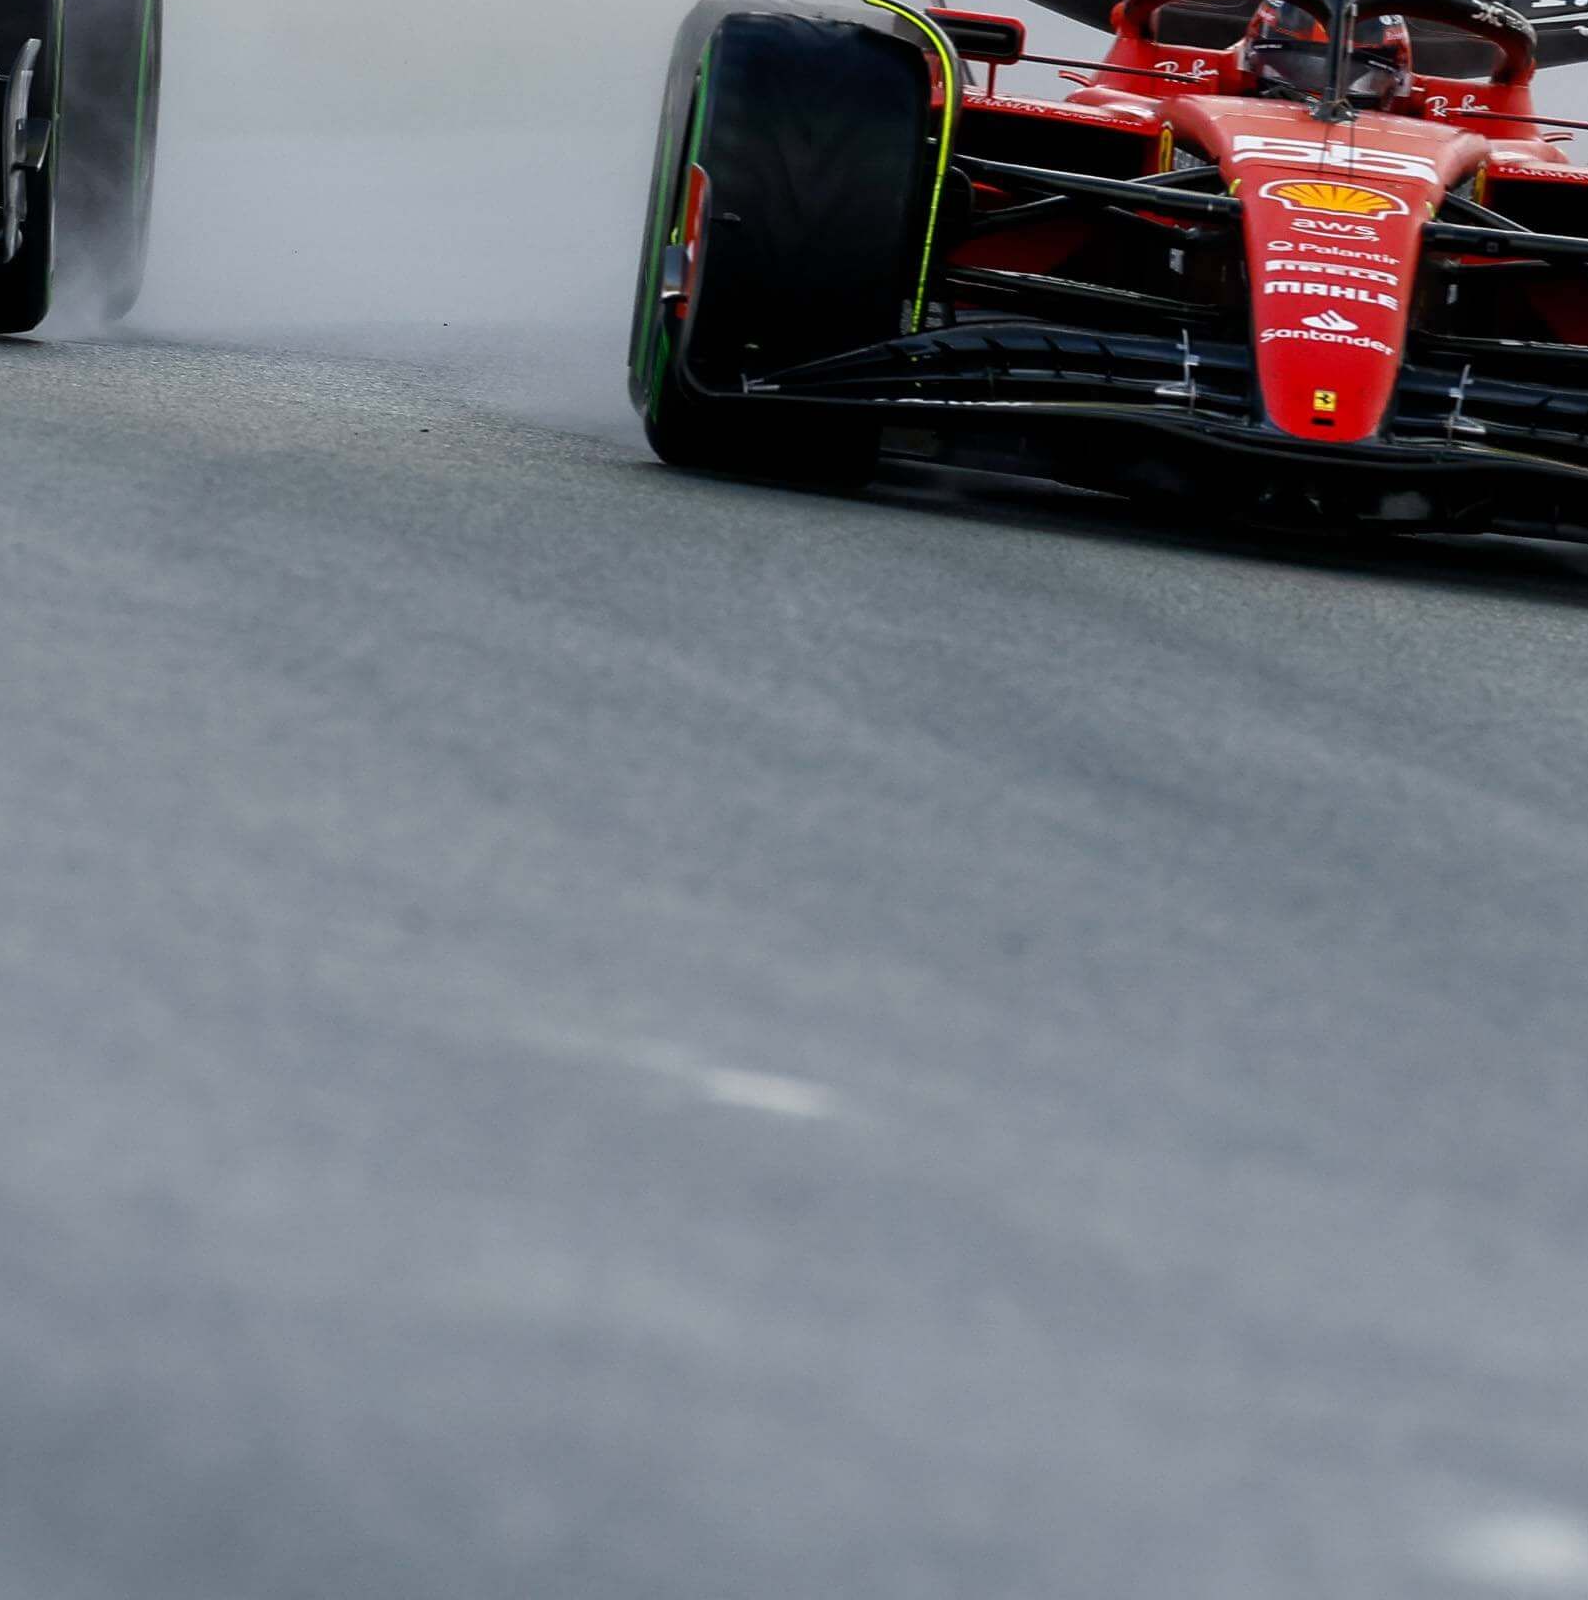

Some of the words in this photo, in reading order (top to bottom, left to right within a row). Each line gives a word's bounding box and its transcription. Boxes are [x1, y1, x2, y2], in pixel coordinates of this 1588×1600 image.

[1231, 134, 1439, 185] 55
[1290, 218, 1377, 236] aws
[1298, 242, 1400, 265] Palantir
[1264, 259, 1399, 286] PIRELLI
[1263, 280, 1399, 312] MAHLE
[1260, 328, 1395, 356] Santander
